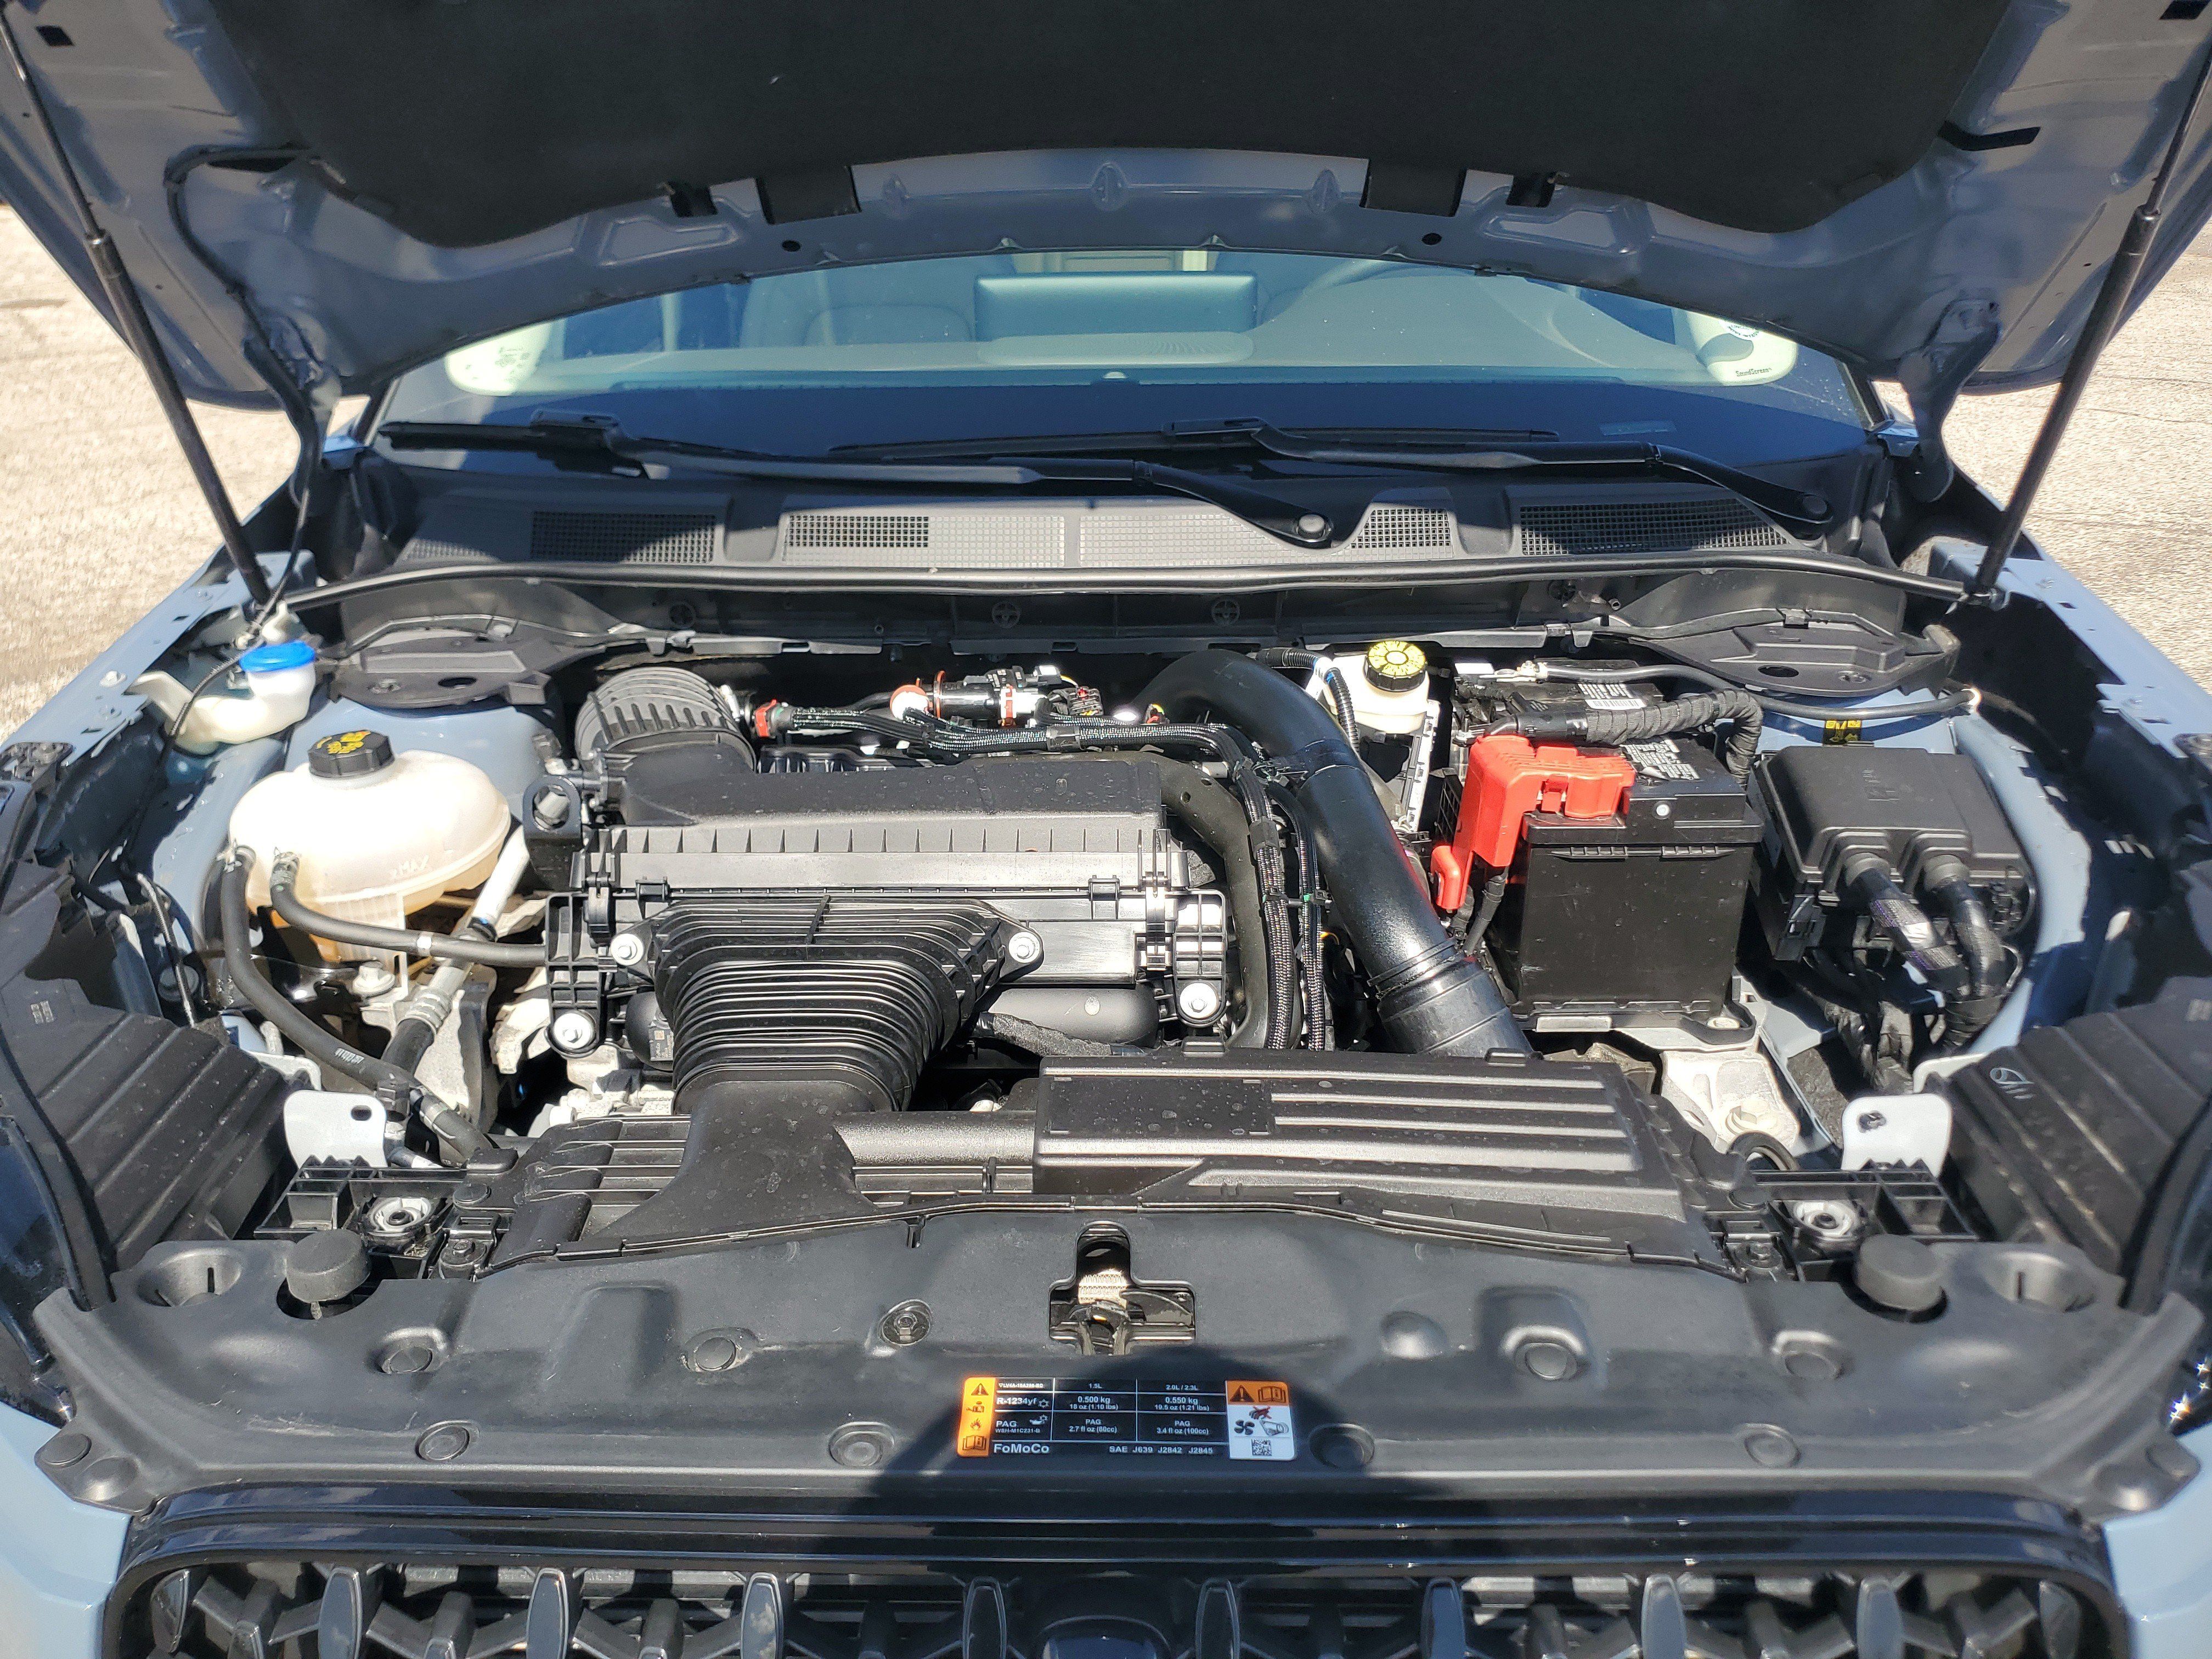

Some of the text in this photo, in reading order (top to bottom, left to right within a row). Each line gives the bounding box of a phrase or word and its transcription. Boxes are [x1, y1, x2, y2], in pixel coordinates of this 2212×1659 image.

[1735, 368, 1769, 377] SoundScreen
[996, 1397, 1037, 1406] R-1234yf
[1101, 1396, 1110, 1404] kg
[1188, 1397, 1198, 1406] kg
[993, 1443, 1050, 1454] FoMoCo
